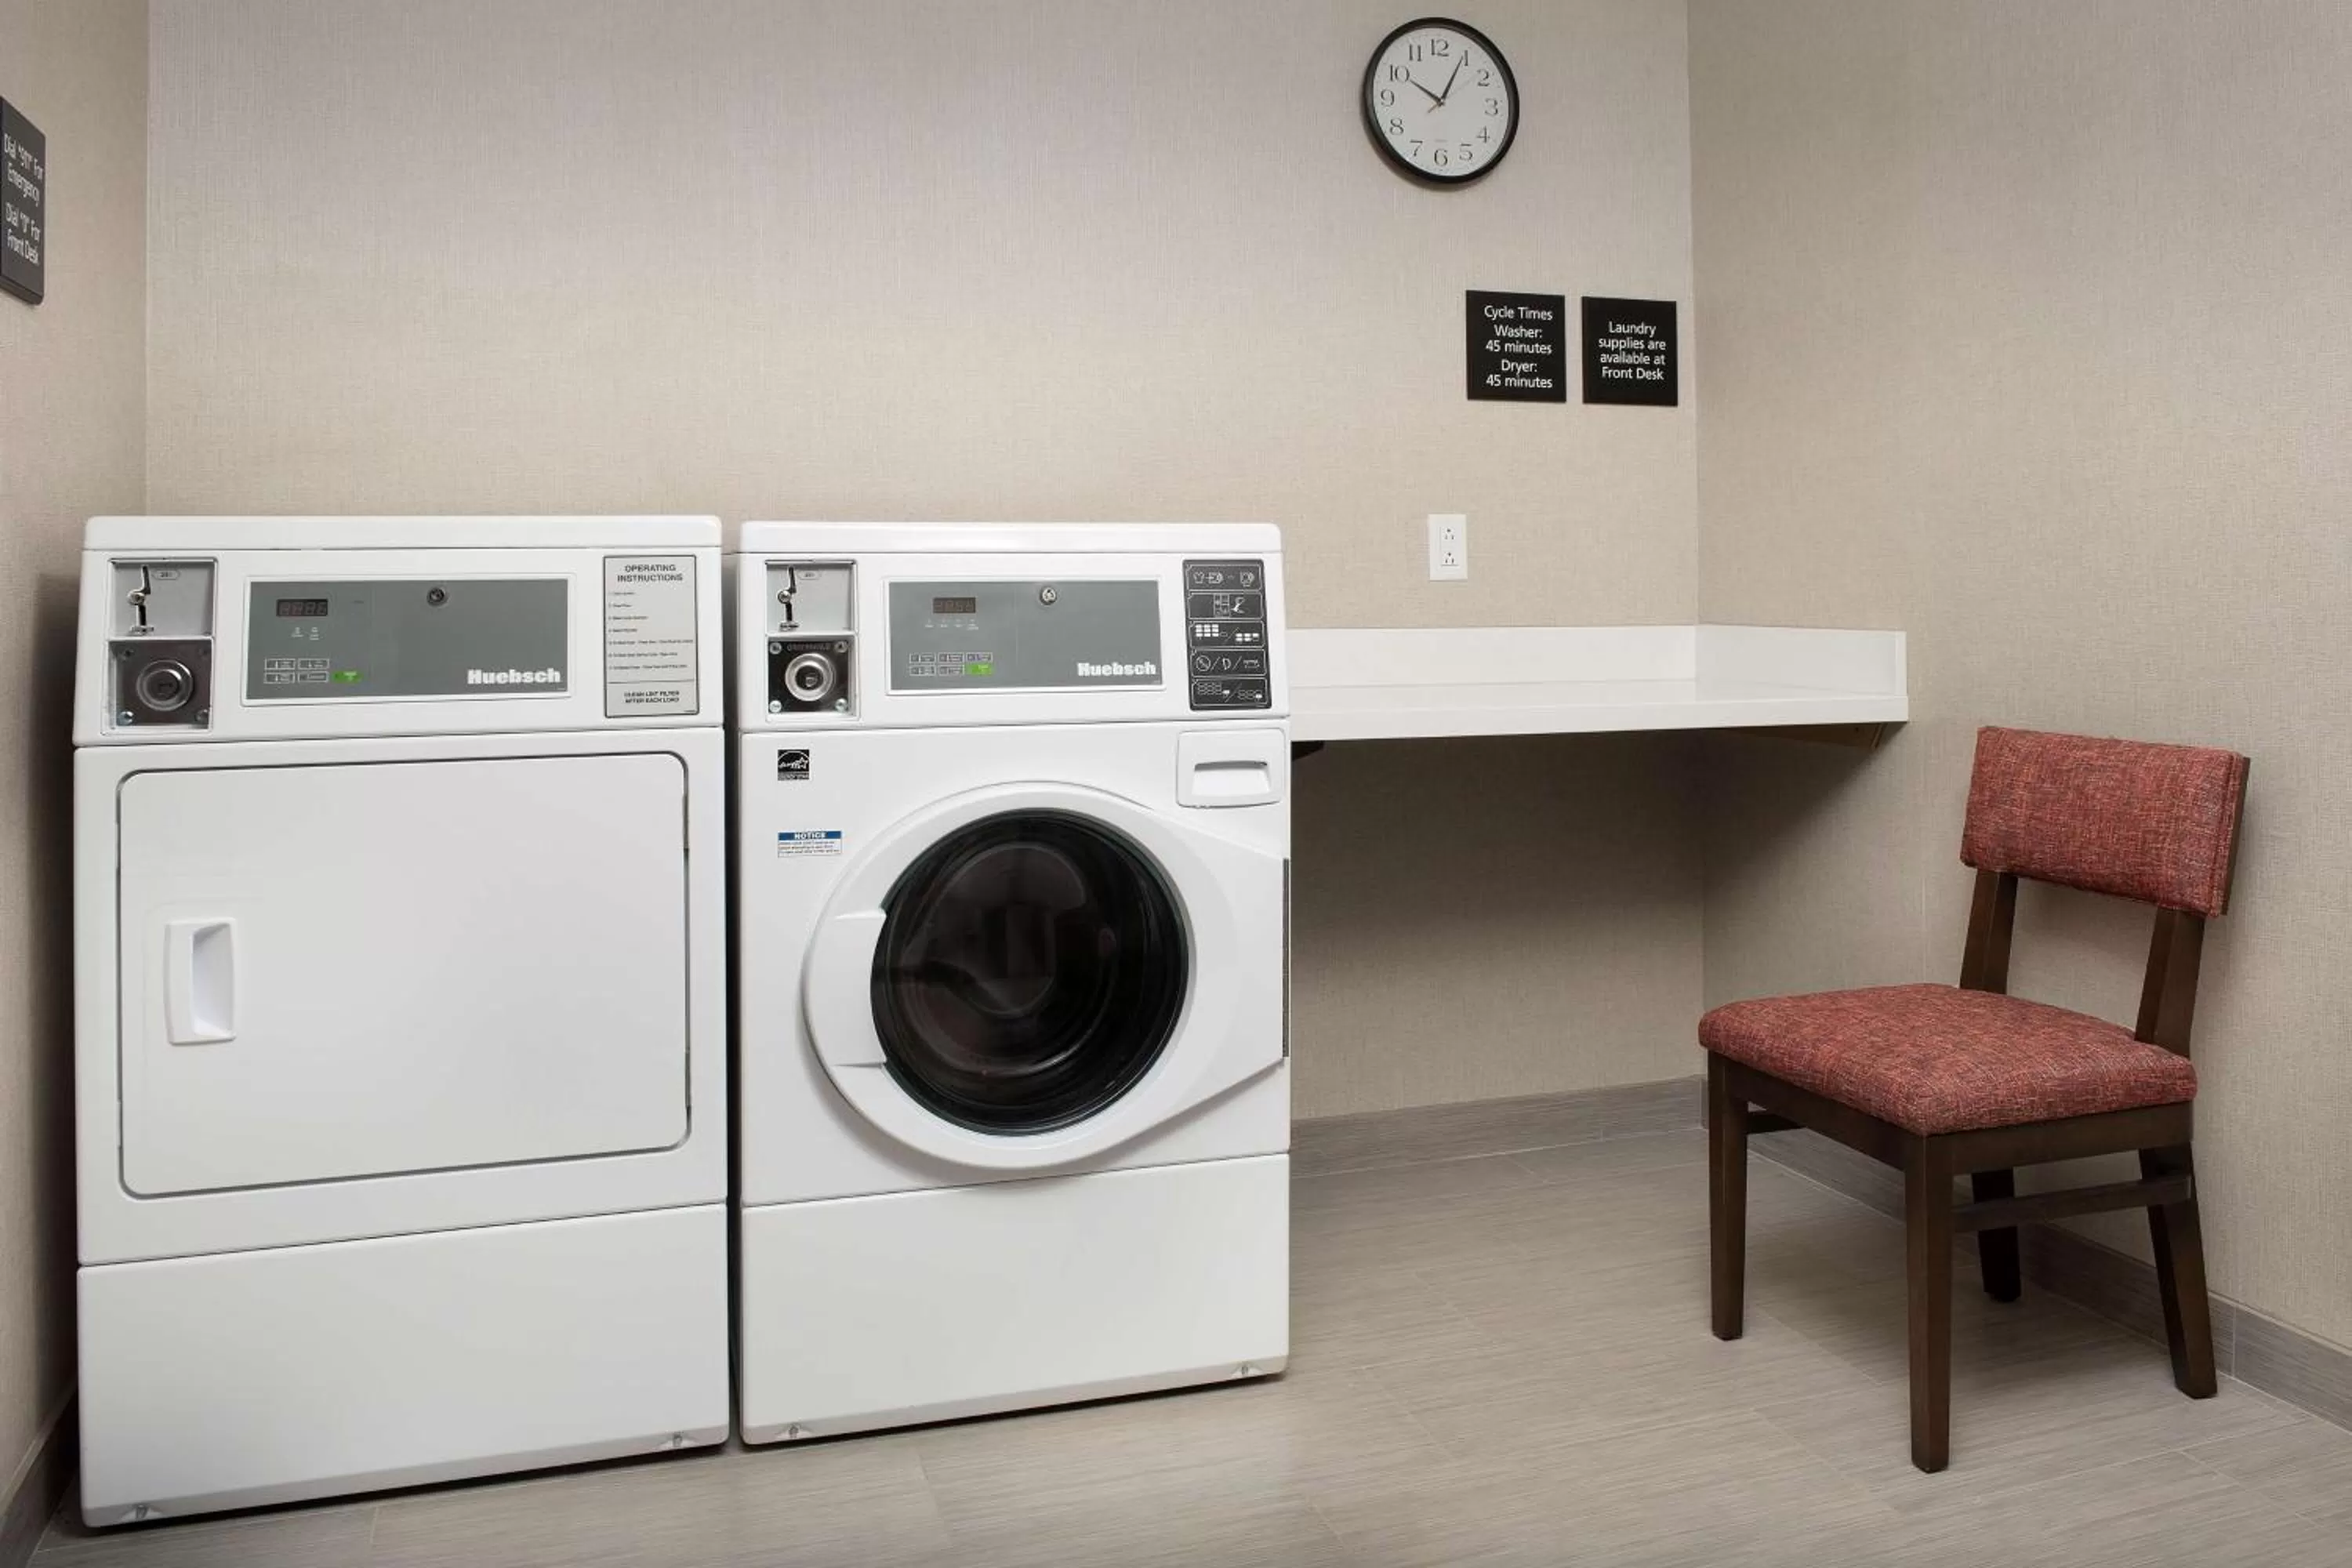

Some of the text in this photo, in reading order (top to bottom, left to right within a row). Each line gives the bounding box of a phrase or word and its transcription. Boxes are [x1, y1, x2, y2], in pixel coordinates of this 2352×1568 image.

[1409, 44, 1421, 62] 11
[1431, 39, 1449, 57] 12
[1463, 50, 1469, 67] 1
[1390, 64, 1410, 82] 10
[1477, 68, 1490, 87] 2
[1380, 89, 1396, 107] 9
[1484, 98, 1499, 117] 3
[1389, 118, 1404, 136] 8
[1476, 125, 1490, 143] 4
[1410, 140, 1424, 157] 7
[1459, 143, 1473, 162] 5
[1434, 148, 1449, 167] 6
[1484, 305, 1553, 321] Cycle Times
[1494, 324, 1543, 339] Washer:
[1609, 321, 1657, 337] Laundry
[1486, 340, 1552, 355] 45 minutes
[1599, 336, 1666, 350] supplies are
[1501, 359, 1537, 374] Dryer:
[1600, 352, 1666, 365] available at
[1486, 374, 1553, 389] 45 minutes
[1602, 366, 1664, 381] Front Desk
[624, 564, 676, 572] OPERATING
[617, 573, 683, 583] INSTRUCTIONS
[467, 668, 561, 684] Huebsch
[1077, 661, 1156, 677] Huebsch
[794, 831, 826, 840] NOTICE
